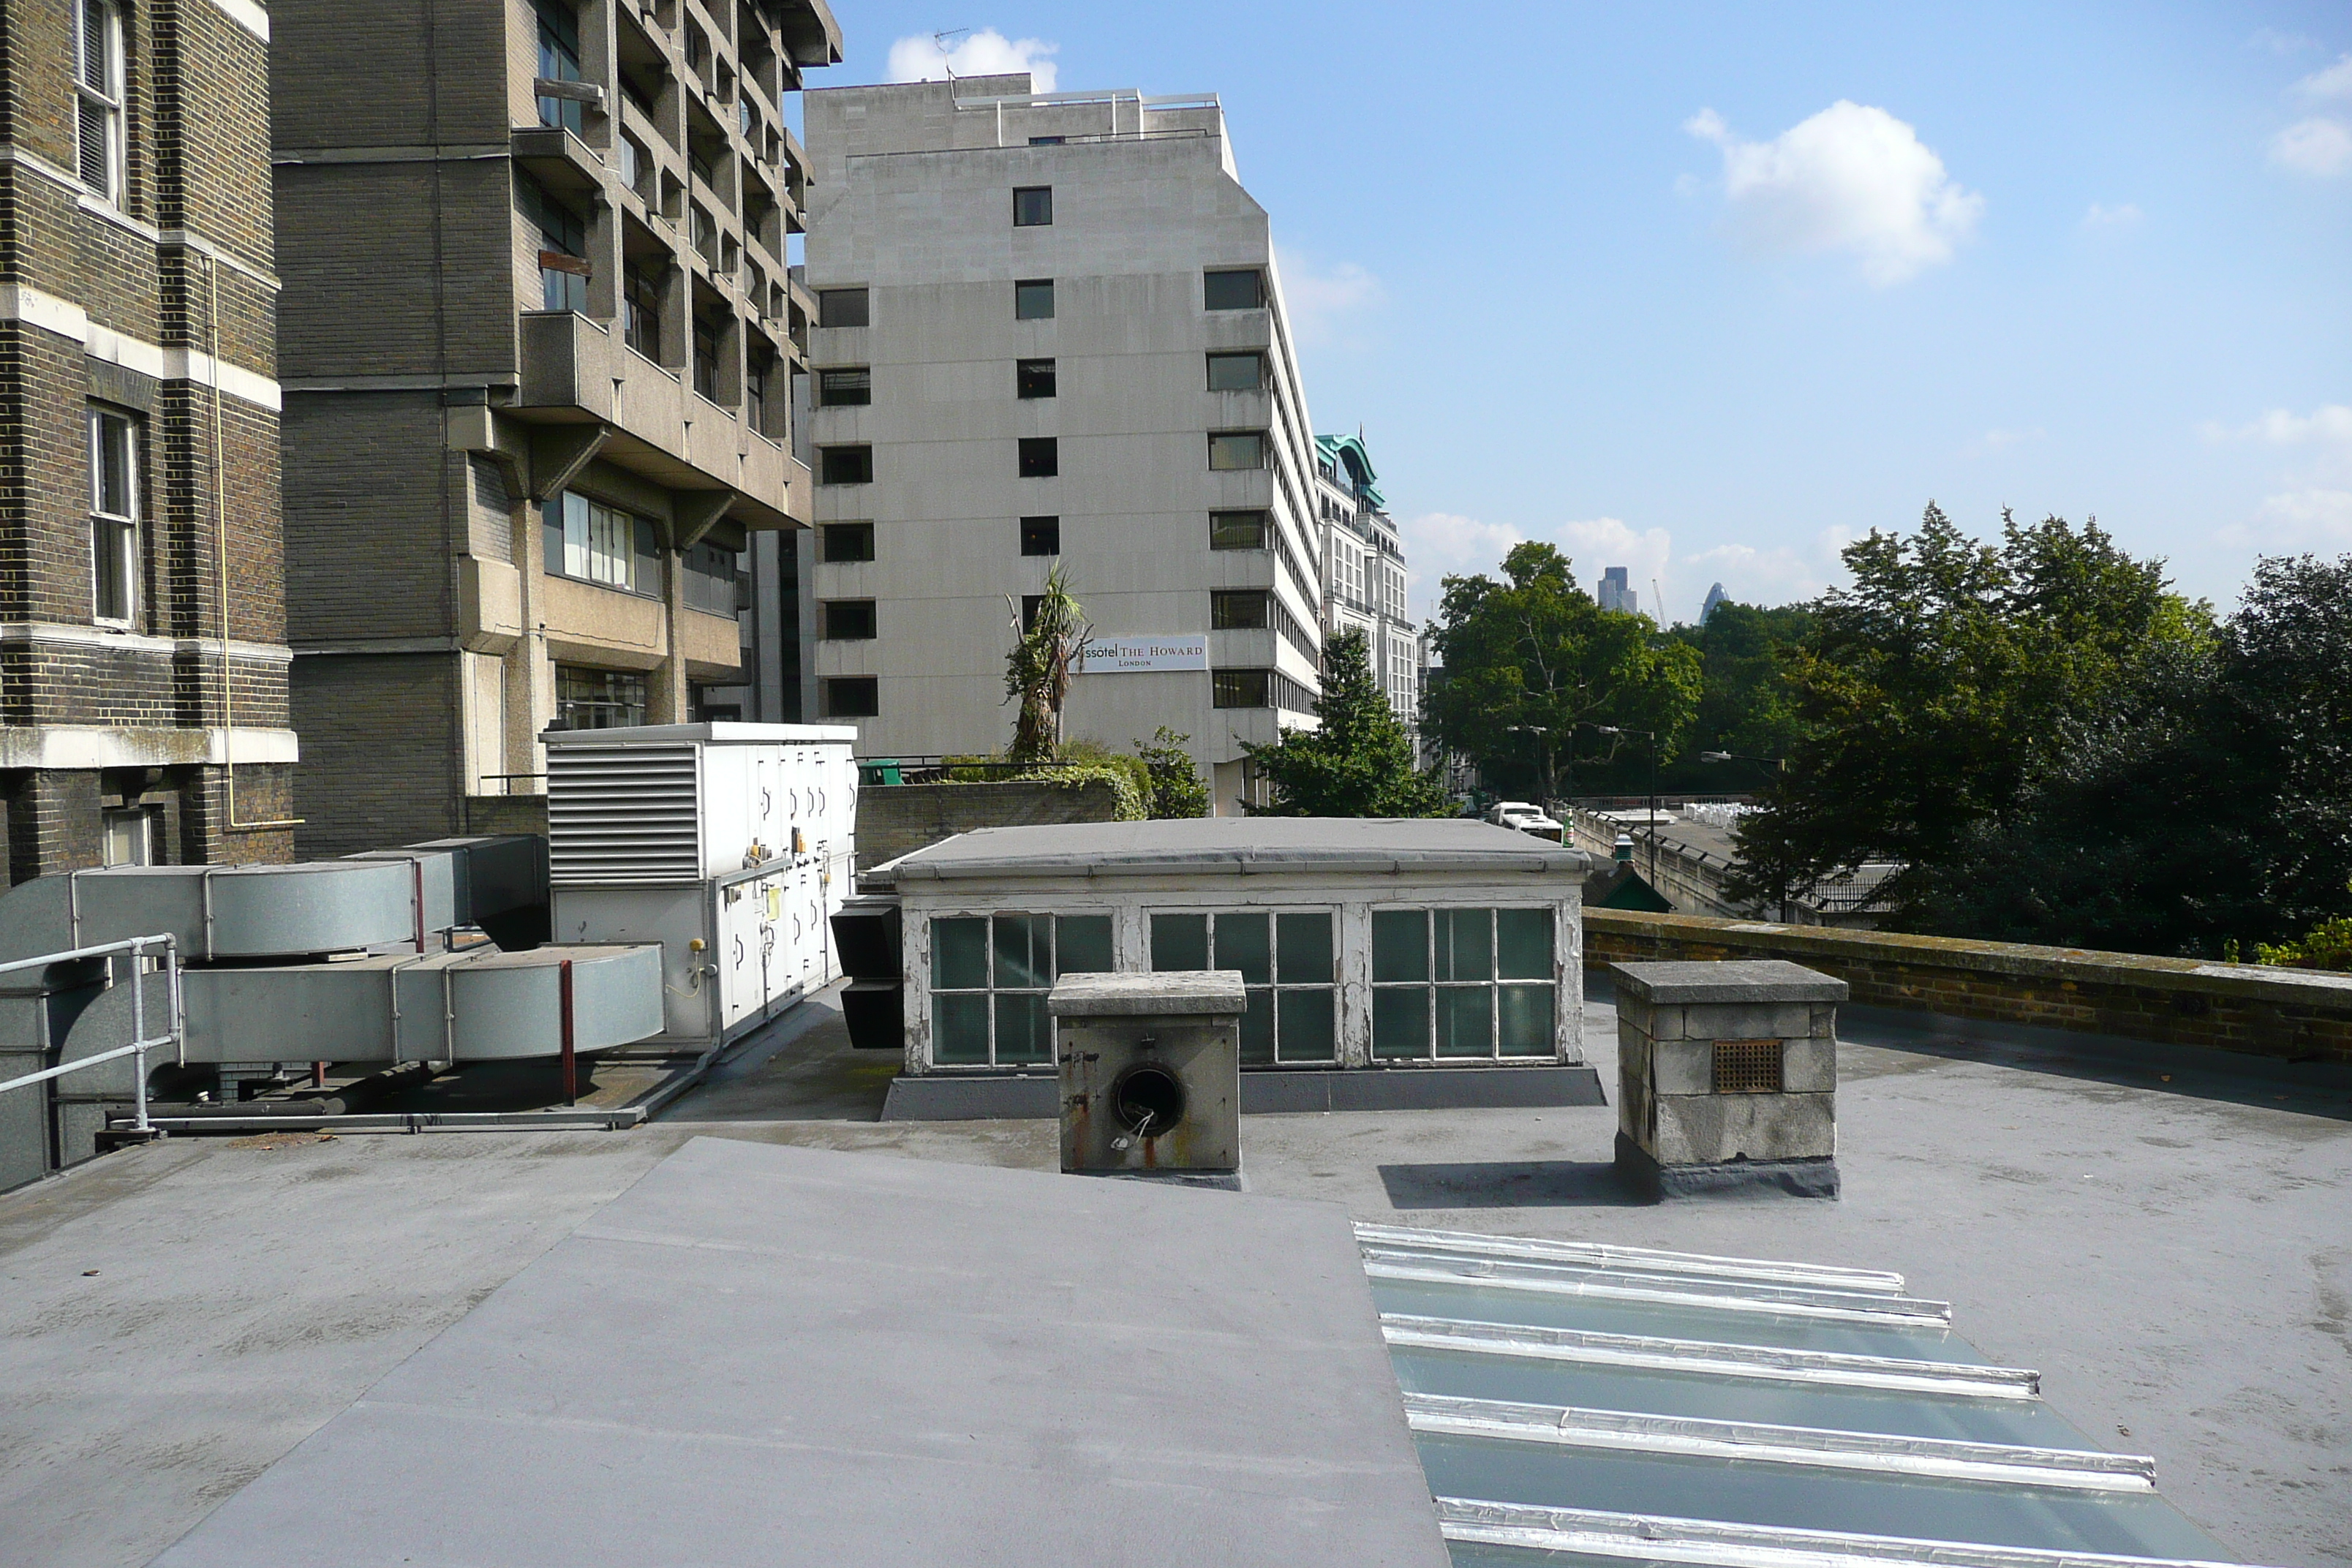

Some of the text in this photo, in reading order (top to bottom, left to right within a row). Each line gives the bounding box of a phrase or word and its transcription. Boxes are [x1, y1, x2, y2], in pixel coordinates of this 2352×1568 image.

[1085, 643, 1202, 657] ssôtel THE HOWARD
